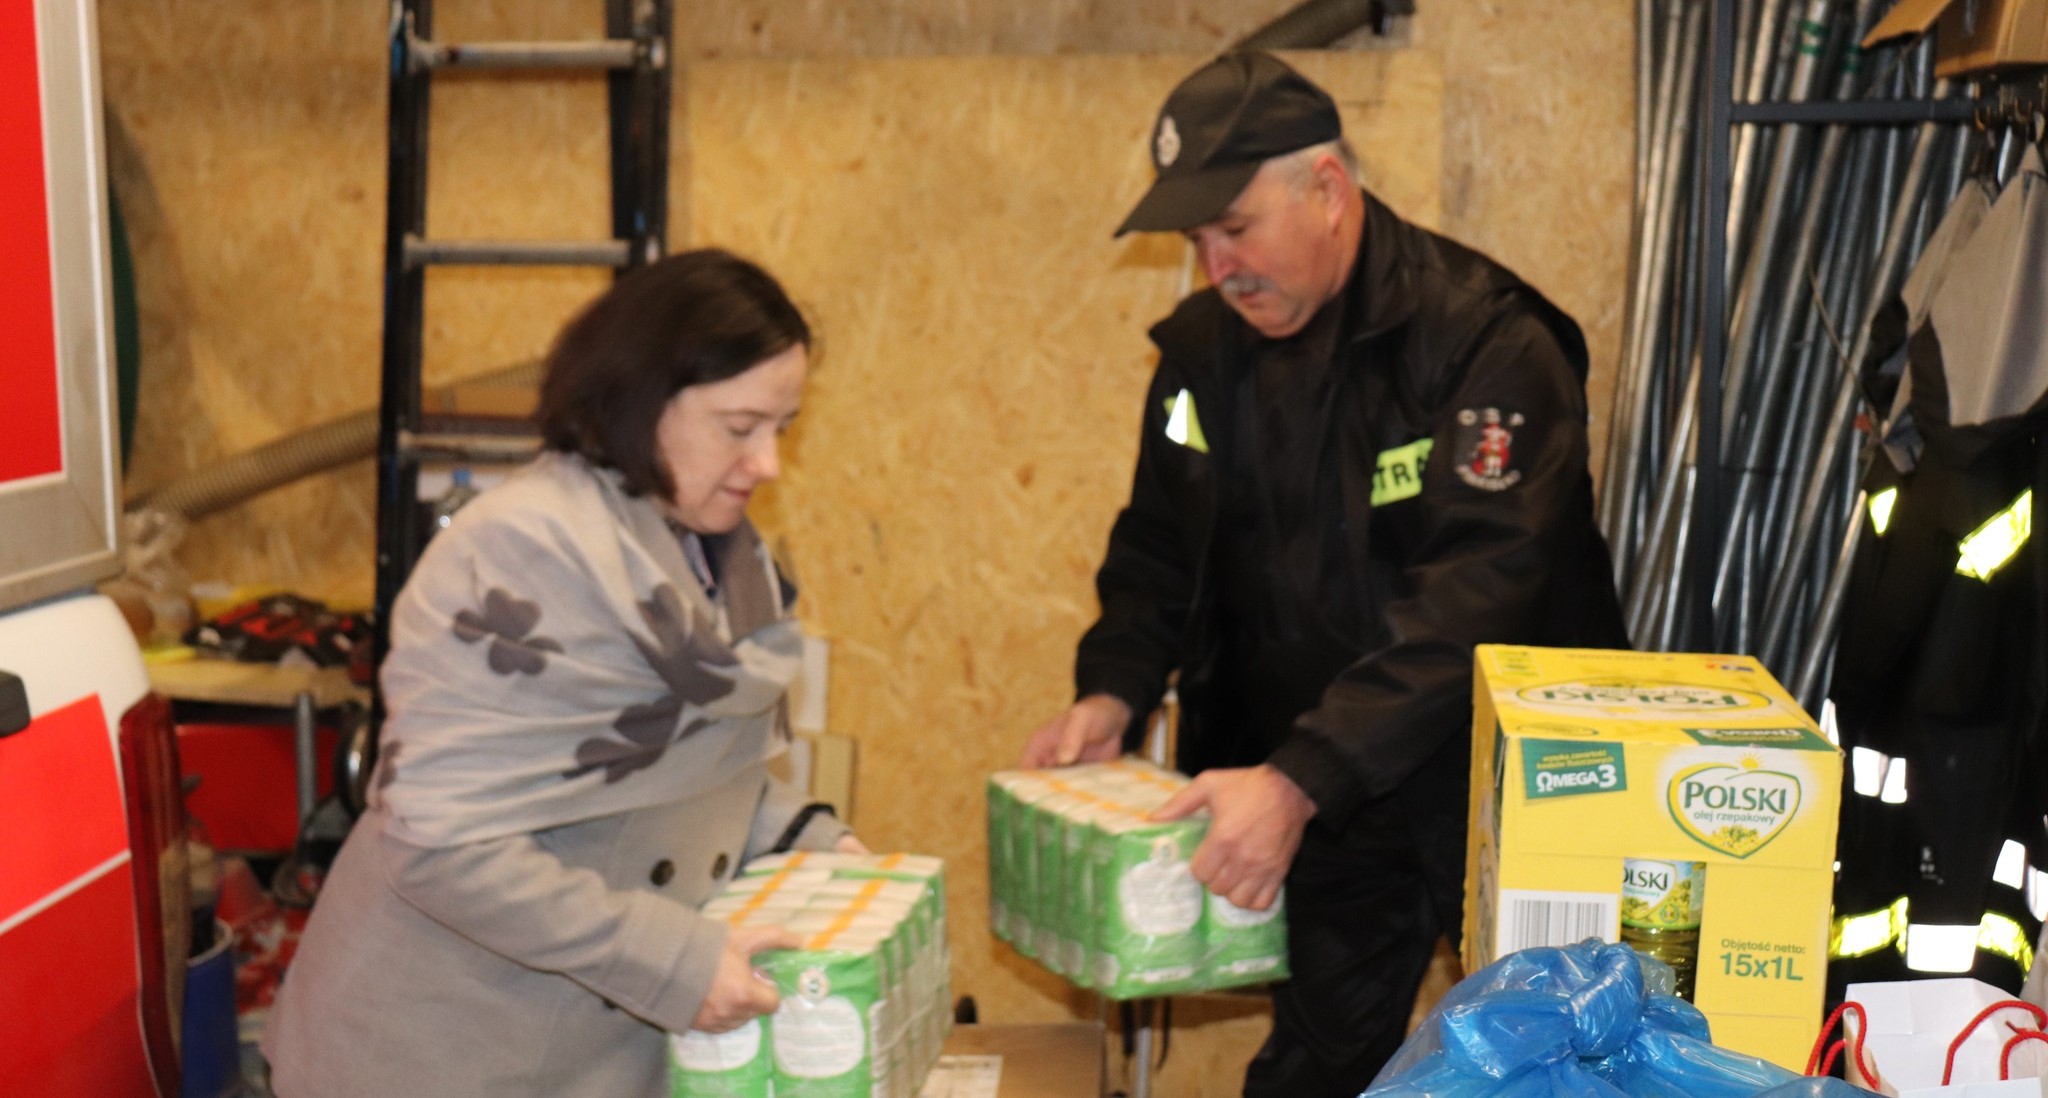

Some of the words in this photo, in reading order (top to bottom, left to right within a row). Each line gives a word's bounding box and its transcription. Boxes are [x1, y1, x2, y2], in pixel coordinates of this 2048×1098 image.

[1684, 781, 1787, 815] POLSKI
[1693, 810, 1714, 823] olej
[1716, 813, 1776, 826] rzepakowy
[1721, 938, 1771, 951] Objętość
[1774, 943, 1806, 954] netto:
[1720, 952, 1804, 981] 15x1L
